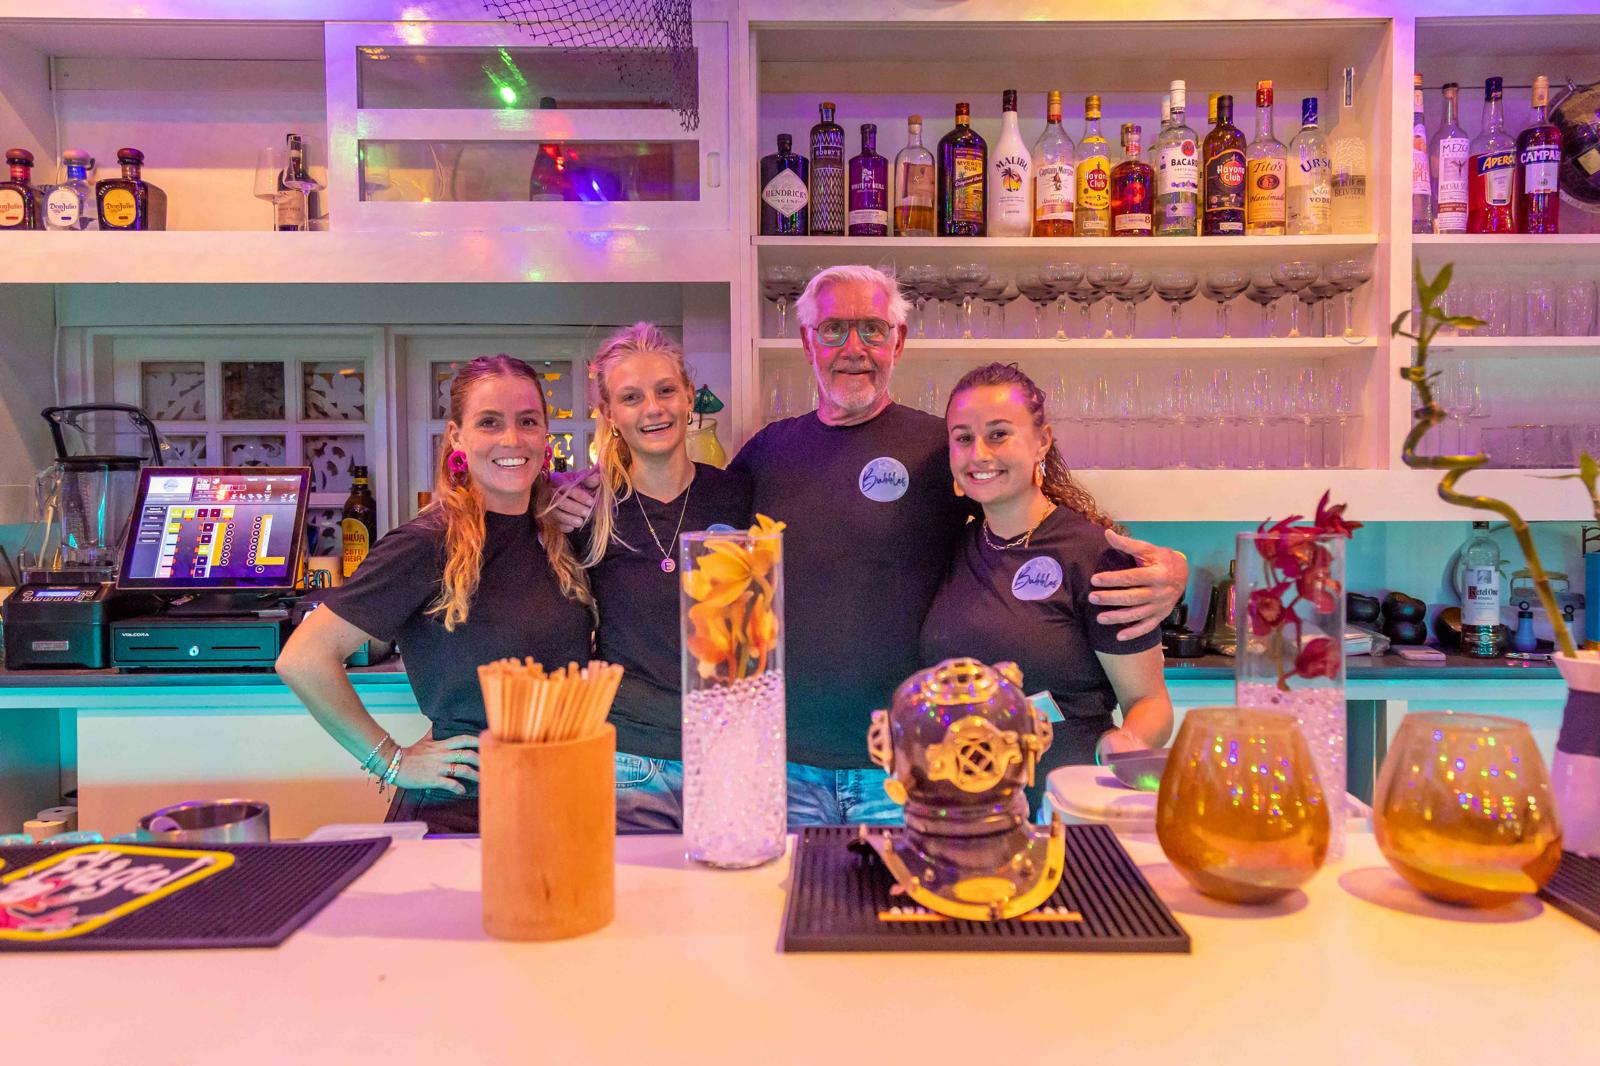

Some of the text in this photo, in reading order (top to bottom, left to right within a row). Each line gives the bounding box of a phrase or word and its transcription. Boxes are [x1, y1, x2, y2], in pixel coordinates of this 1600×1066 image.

[1442, 143, 1469, 153] MEZC
[1520, 149, 1561, 164] CAMPAR
[1171, 158, 1198, 168] BACAR
[1300, 157, 1332, 173] URS
[1483, 154, 1516, 171] APERO
[1223, 173, 1241, 182] Club
[664, 561, 672, 571] E
